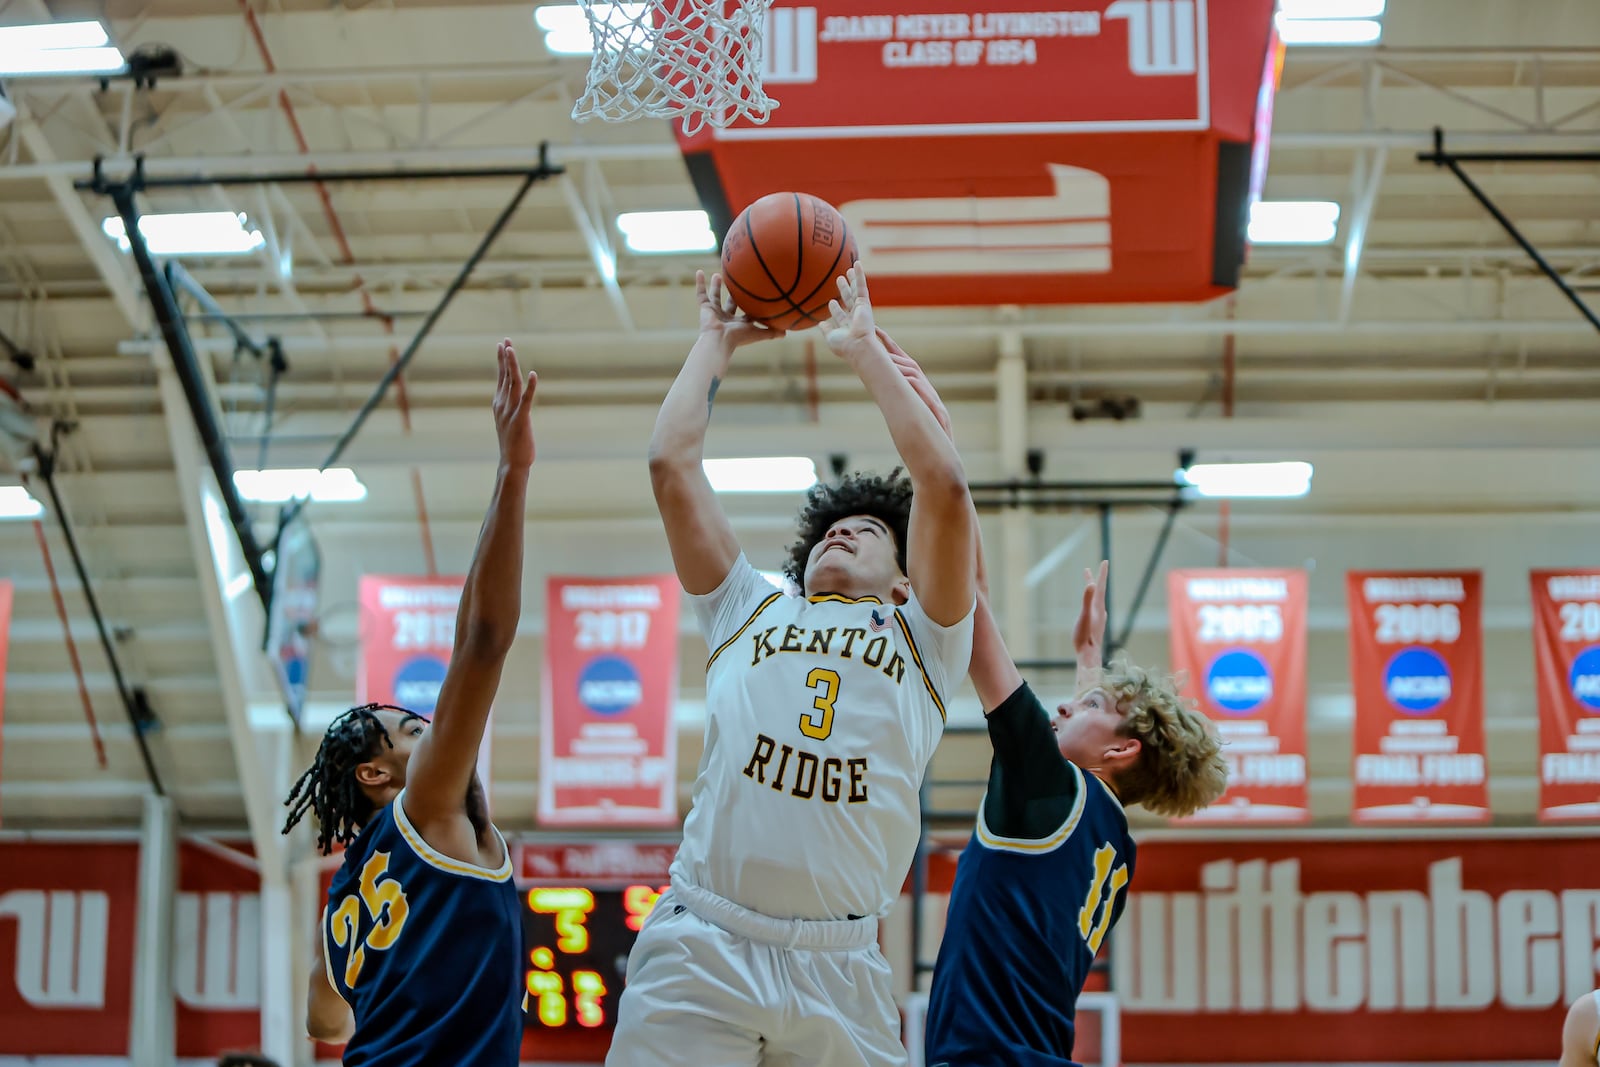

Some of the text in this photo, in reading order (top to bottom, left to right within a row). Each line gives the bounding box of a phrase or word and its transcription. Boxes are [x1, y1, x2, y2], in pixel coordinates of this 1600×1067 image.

[882, 41, 953, 68] CLASS
[955, 40, 983, 66] OF
[895, 12, 970, 39] MEYER
[972, 10, 1101, 37] LIVINGSTON
[752, 623, 906, 685] KENTON
[1197, 605, 1284, 643] 2005
[799, 667, 841, 741] 3
[743, 733, 869, 804] RIDGE
[1356, 754, 1485, 786] FINAL FOUR
[330, 850, 410, 989] 25
[1077, 840, 1129, 959] 11
